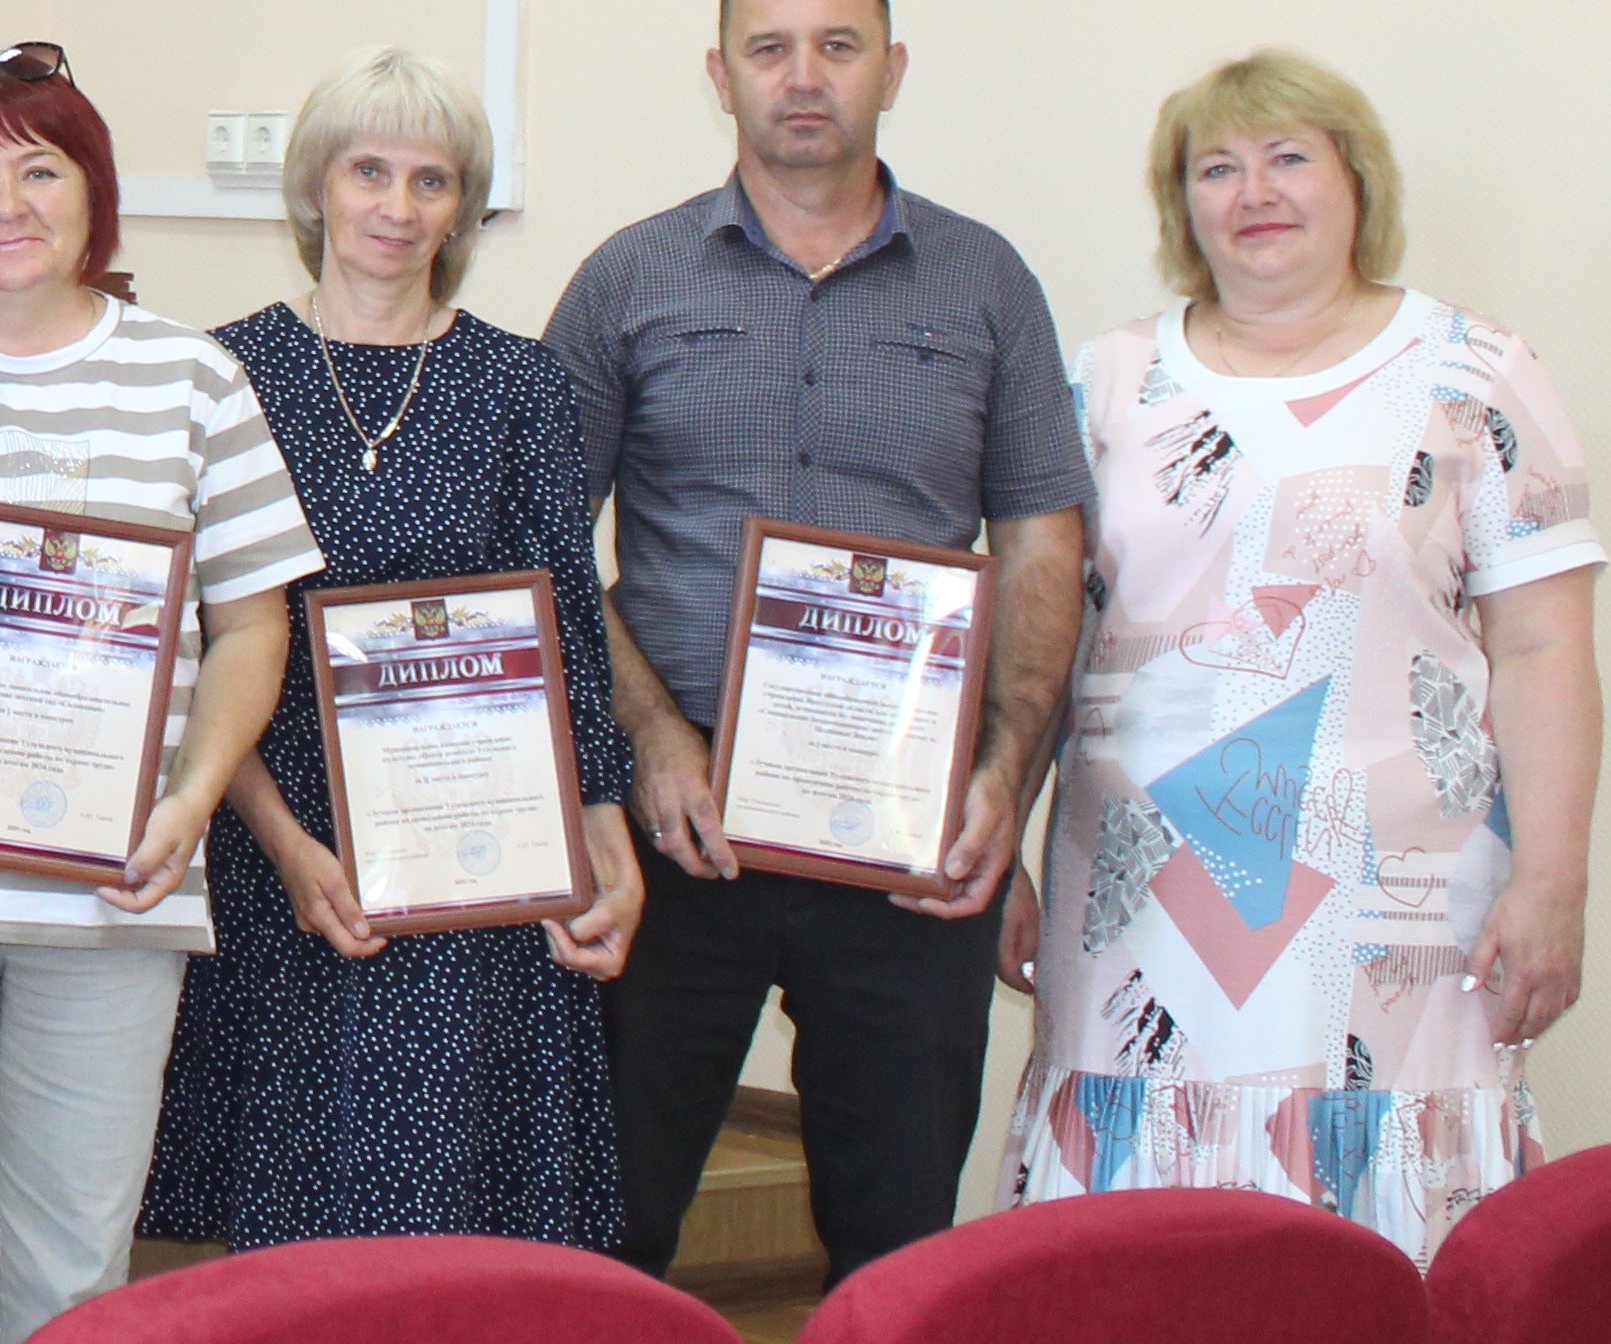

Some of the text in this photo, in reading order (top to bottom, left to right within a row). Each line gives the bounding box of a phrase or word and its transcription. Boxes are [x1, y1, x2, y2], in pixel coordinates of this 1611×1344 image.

[798, 605, 931, 645] ДИПЛОМ
[8, 653, 78, 673] НАГРАЖДАЕТ
[378, 653, 504, 687] ДИПЛОМ
